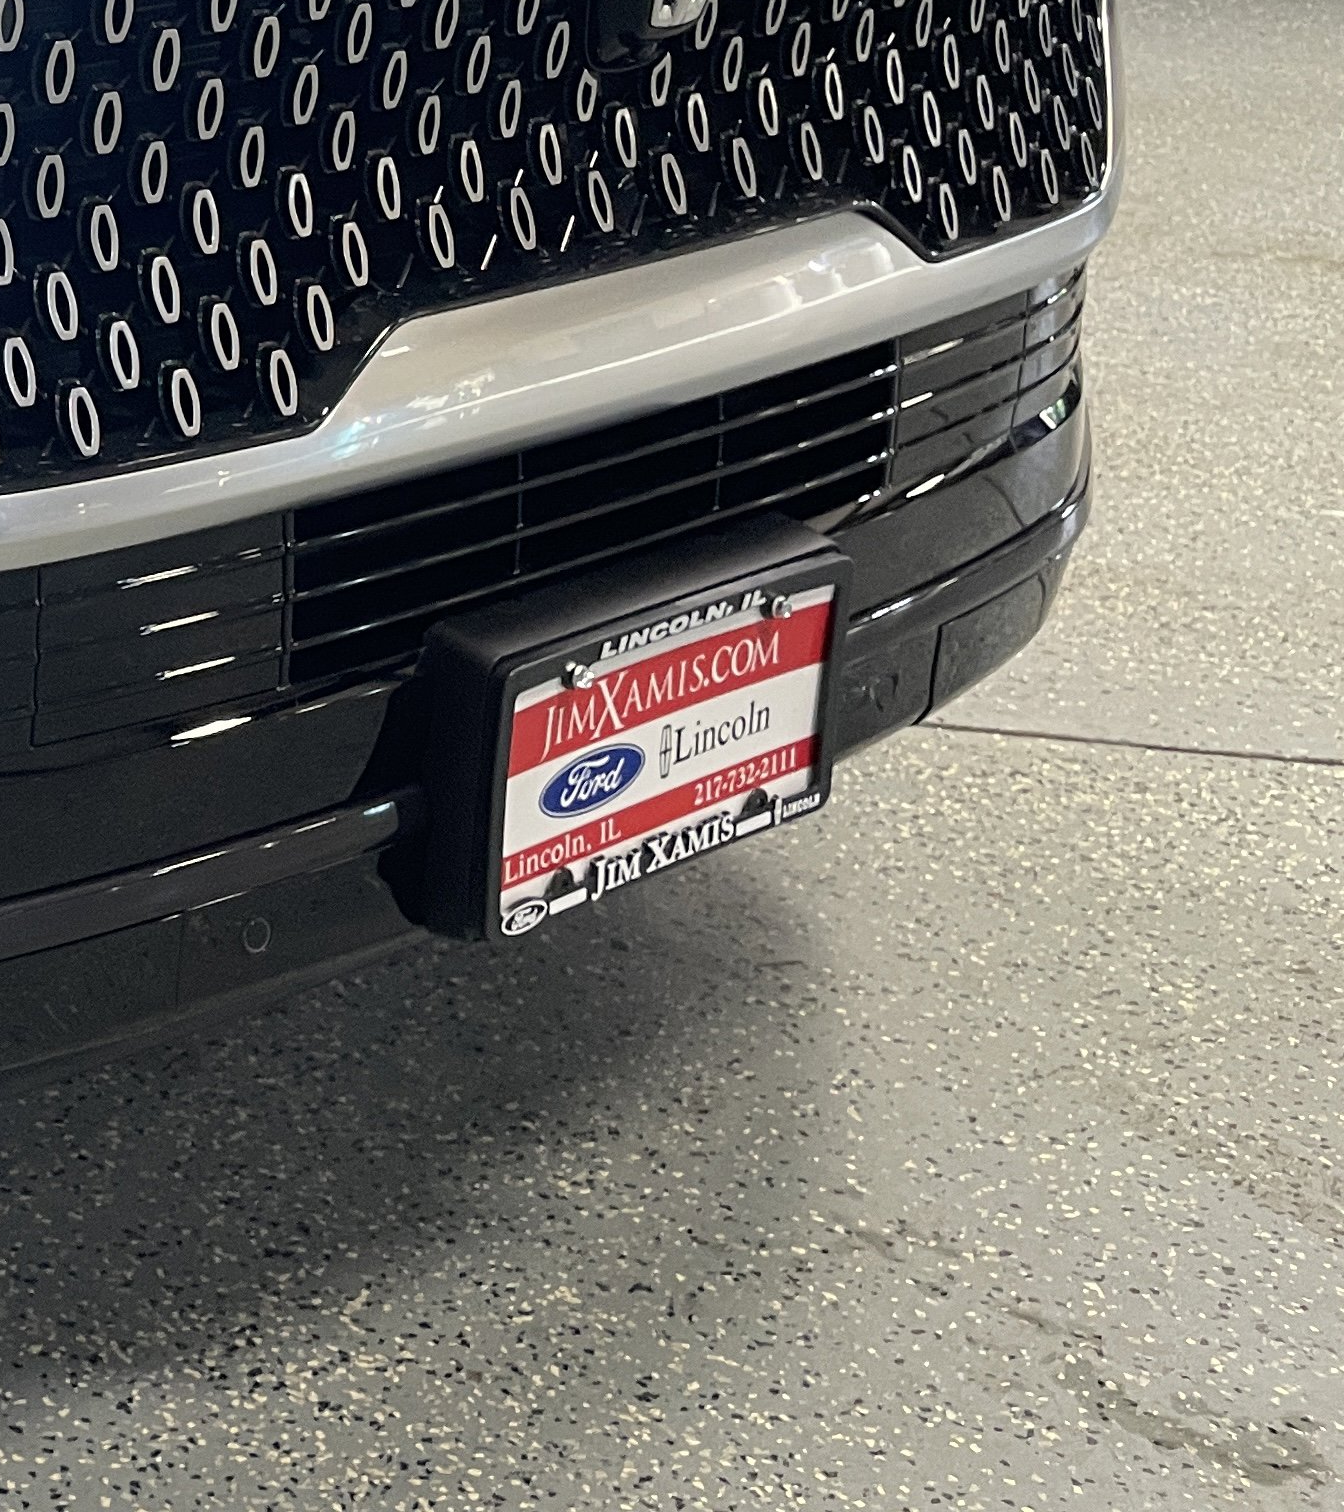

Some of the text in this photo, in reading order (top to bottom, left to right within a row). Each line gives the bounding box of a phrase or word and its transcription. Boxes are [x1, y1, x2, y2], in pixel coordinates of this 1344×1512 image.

[600, 589, 767, 660] LINCOLN, IL
[542, 633, 780, 761] JIMXAMIS.COM
[674, 702, 771, 765] Lincoln
[560, 757, 624, 807] Ford
[693, 746, 798, 808] 217-732-2111
[591, 816, 736, 900] JIM XAMIS
[599, 820, 622, 847] IL
